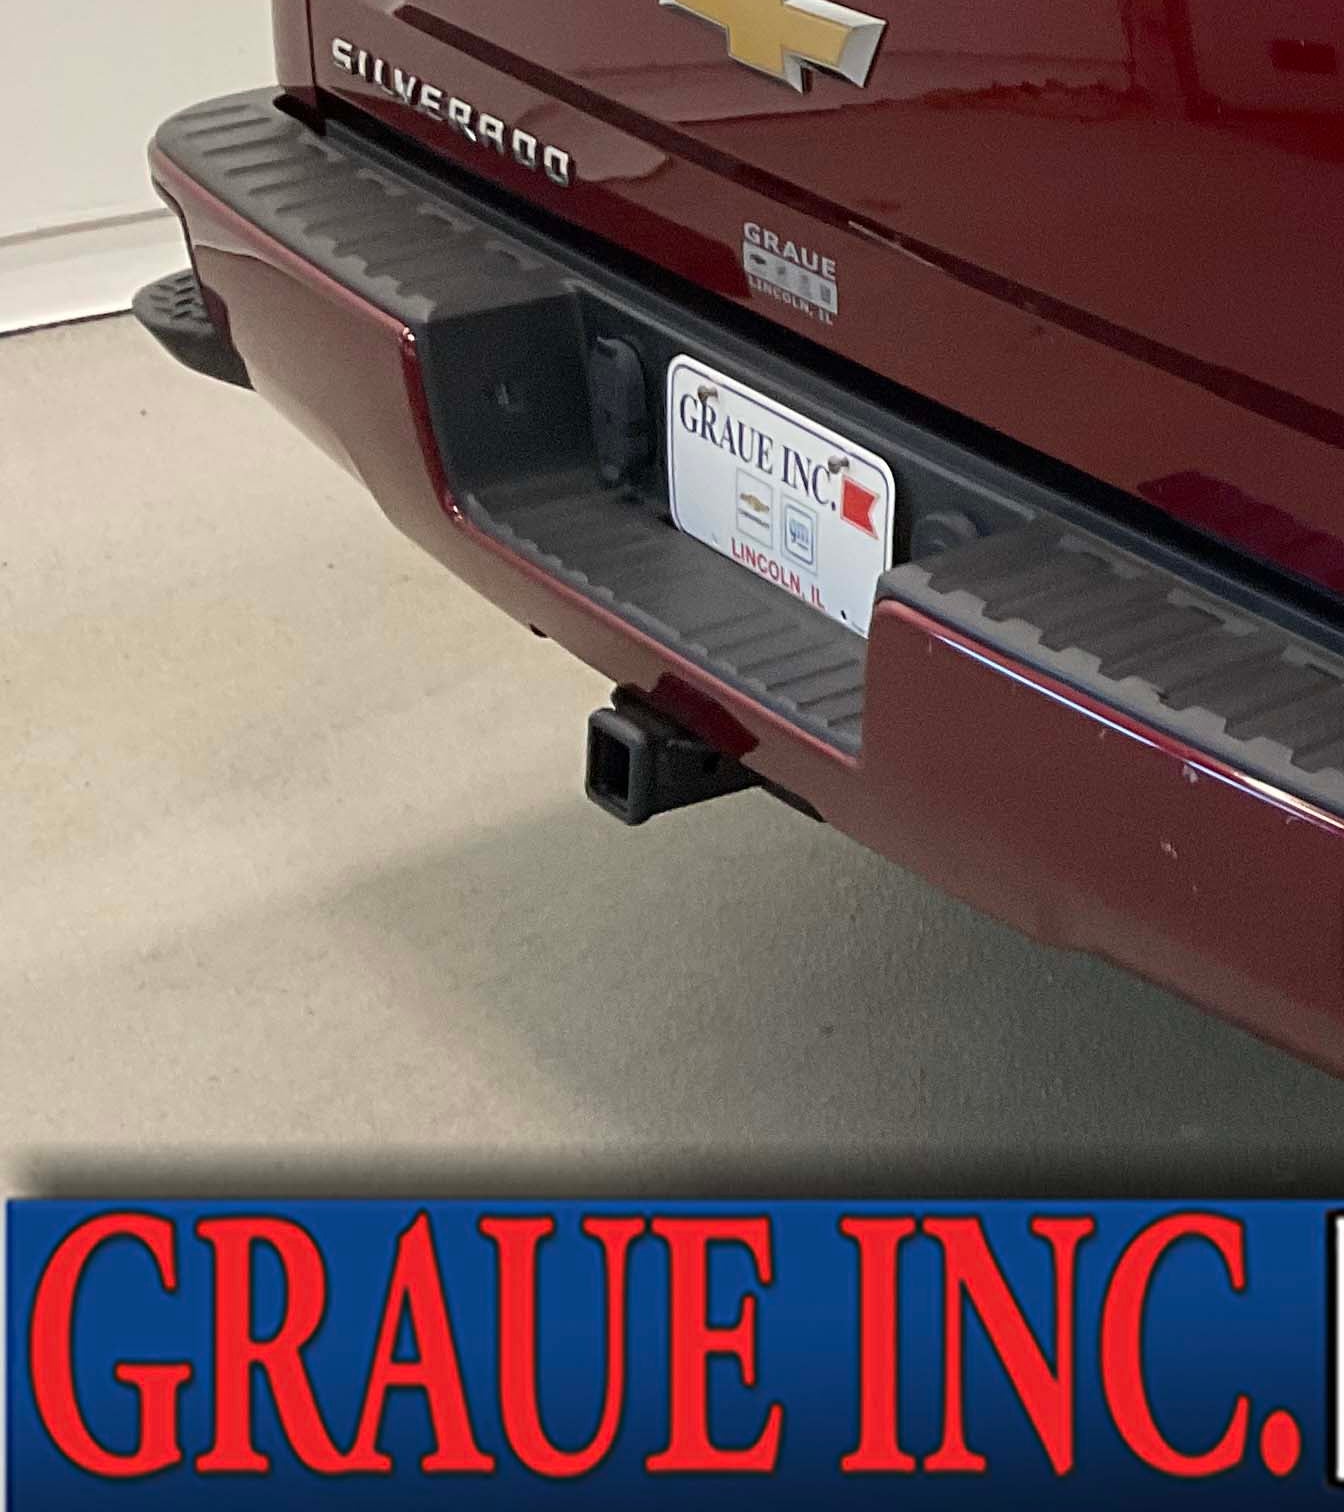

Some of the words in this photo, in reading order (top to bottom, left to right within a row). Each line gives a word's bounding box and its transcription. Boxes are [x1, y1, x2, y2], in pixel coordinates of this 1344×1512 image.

[331, 37, 570, 188] SILVERADO
[743, 221, 837, 281] GRAUE
[818, 307, 834, 326] IL
[679, 393, 774, 475] GRAUE
[781, 444, 837, 512] INC.
[810, 583, 826, 610] IL
